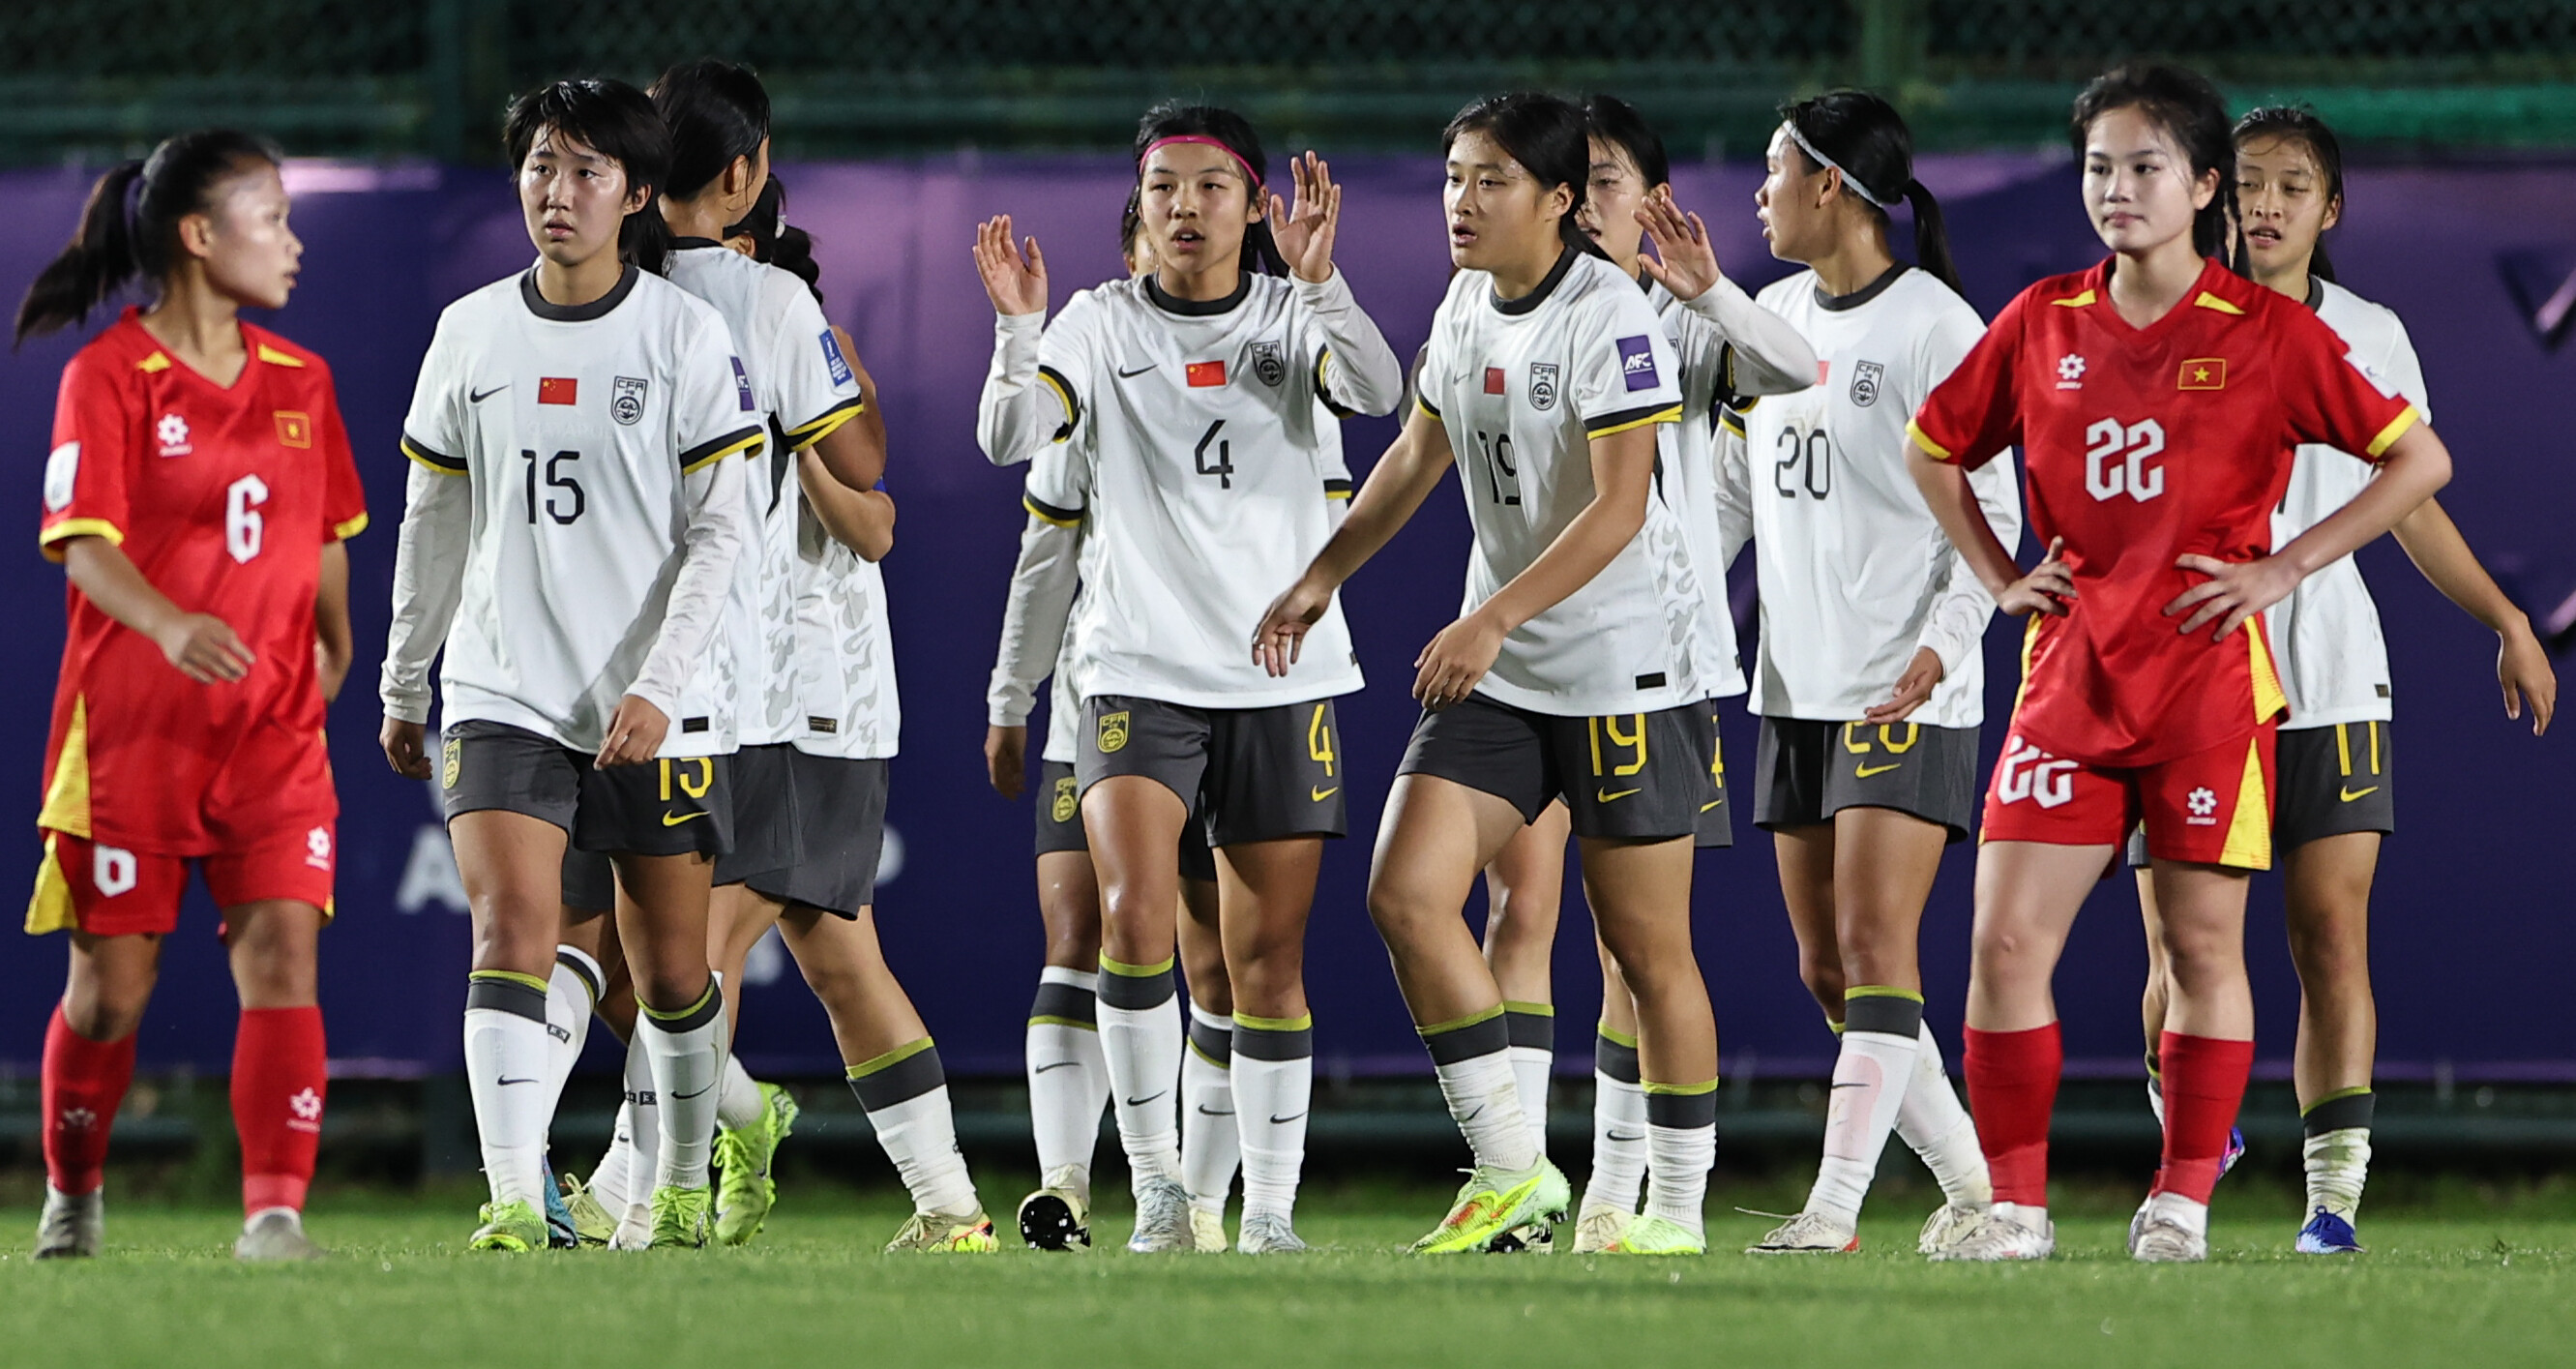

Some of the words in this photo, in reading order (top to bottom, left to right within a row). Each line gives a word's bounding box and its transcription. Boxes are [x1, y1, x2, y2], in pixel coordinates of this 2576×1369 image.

[1254, 343, 1279, 355] CFA
[1532, 366, 1556, 375] CFA
[1624, 352, 1651, 371] AFC
[1858, 364, 1881, 374] CFA
[617, 378, 644, 391] CFA
[520, 449, 585, 525] 15
[1194, 419, 1234, 490] 4
[1477, 431, 1522, 506] 19
[1774, 426, 1831, 501] 20
[2086, 417, 2165, 503] 22
[225, 473, 269, 564] 6
[1308, 703, 1334, 777] 4
[1588, 712, 1647, 776] 19
[2335, 720, 2381, 777] 11
